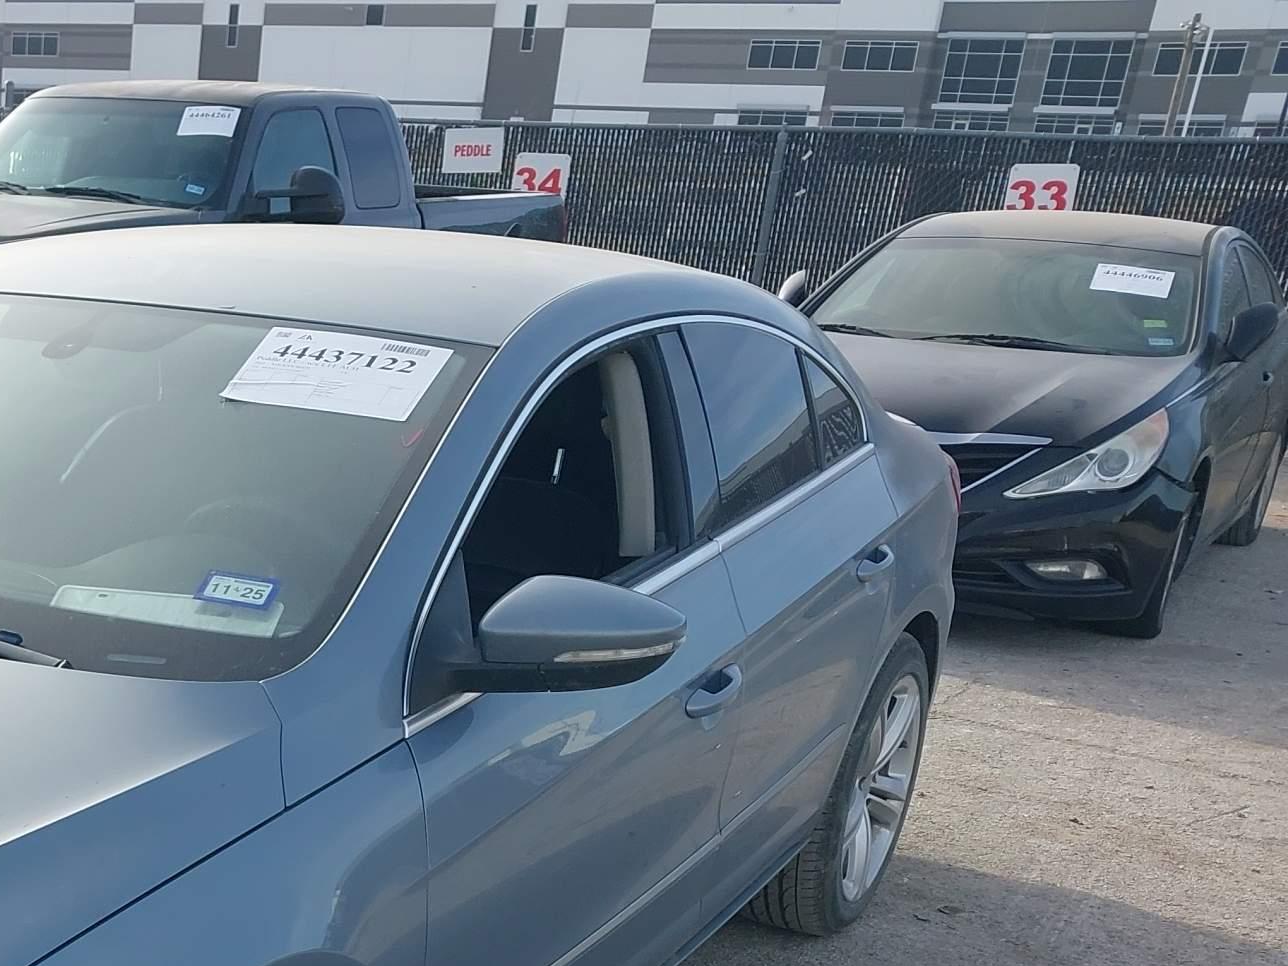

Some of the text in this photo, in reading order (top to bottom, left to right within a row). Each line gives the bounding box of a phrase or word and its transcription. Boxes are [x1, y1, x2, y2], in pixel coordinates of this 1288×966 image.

[454, 144, 492, 157] PEDDLE
[516, 167, 561, 193] 34
[1006, 179, 1068, 210] 33
[272, 343, 418, 374] 44437122
